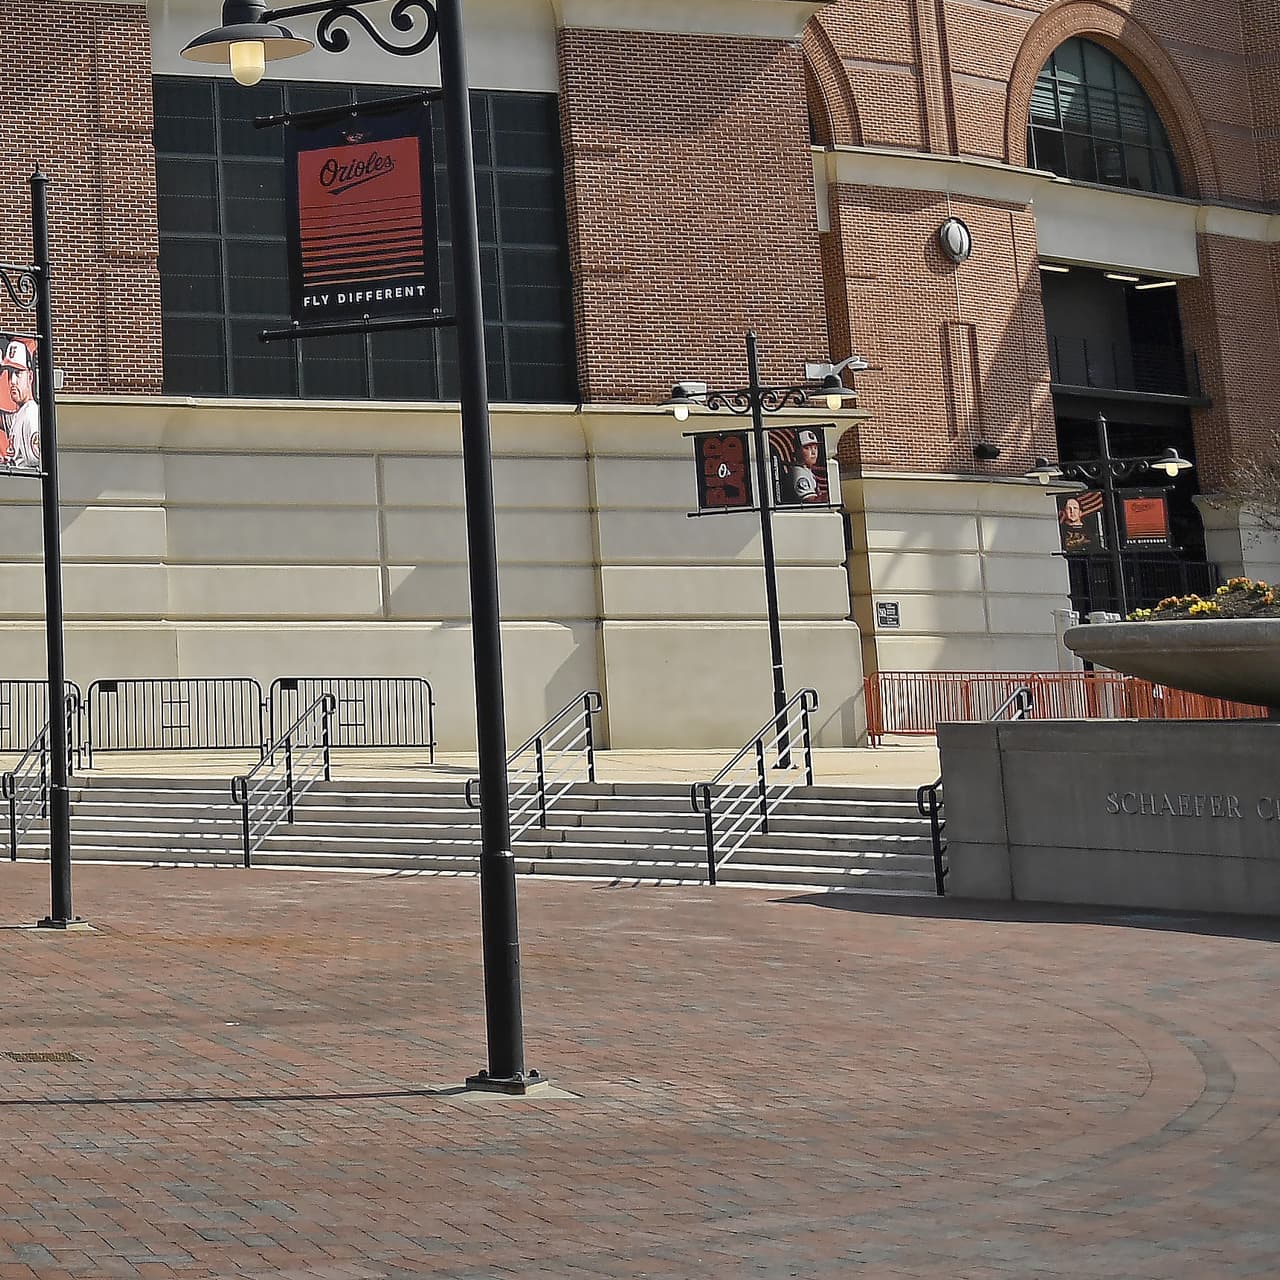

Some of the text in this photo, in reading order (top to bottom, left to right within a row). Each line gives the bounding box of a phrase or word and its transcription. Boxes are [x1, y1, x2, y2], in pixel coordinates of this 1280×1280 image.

[319, 151, 396, 194] Orioles
[303, 285, 426, 308] FLY DIFFERENT
[1105, 791, 1243, 819] SCHAEFER
